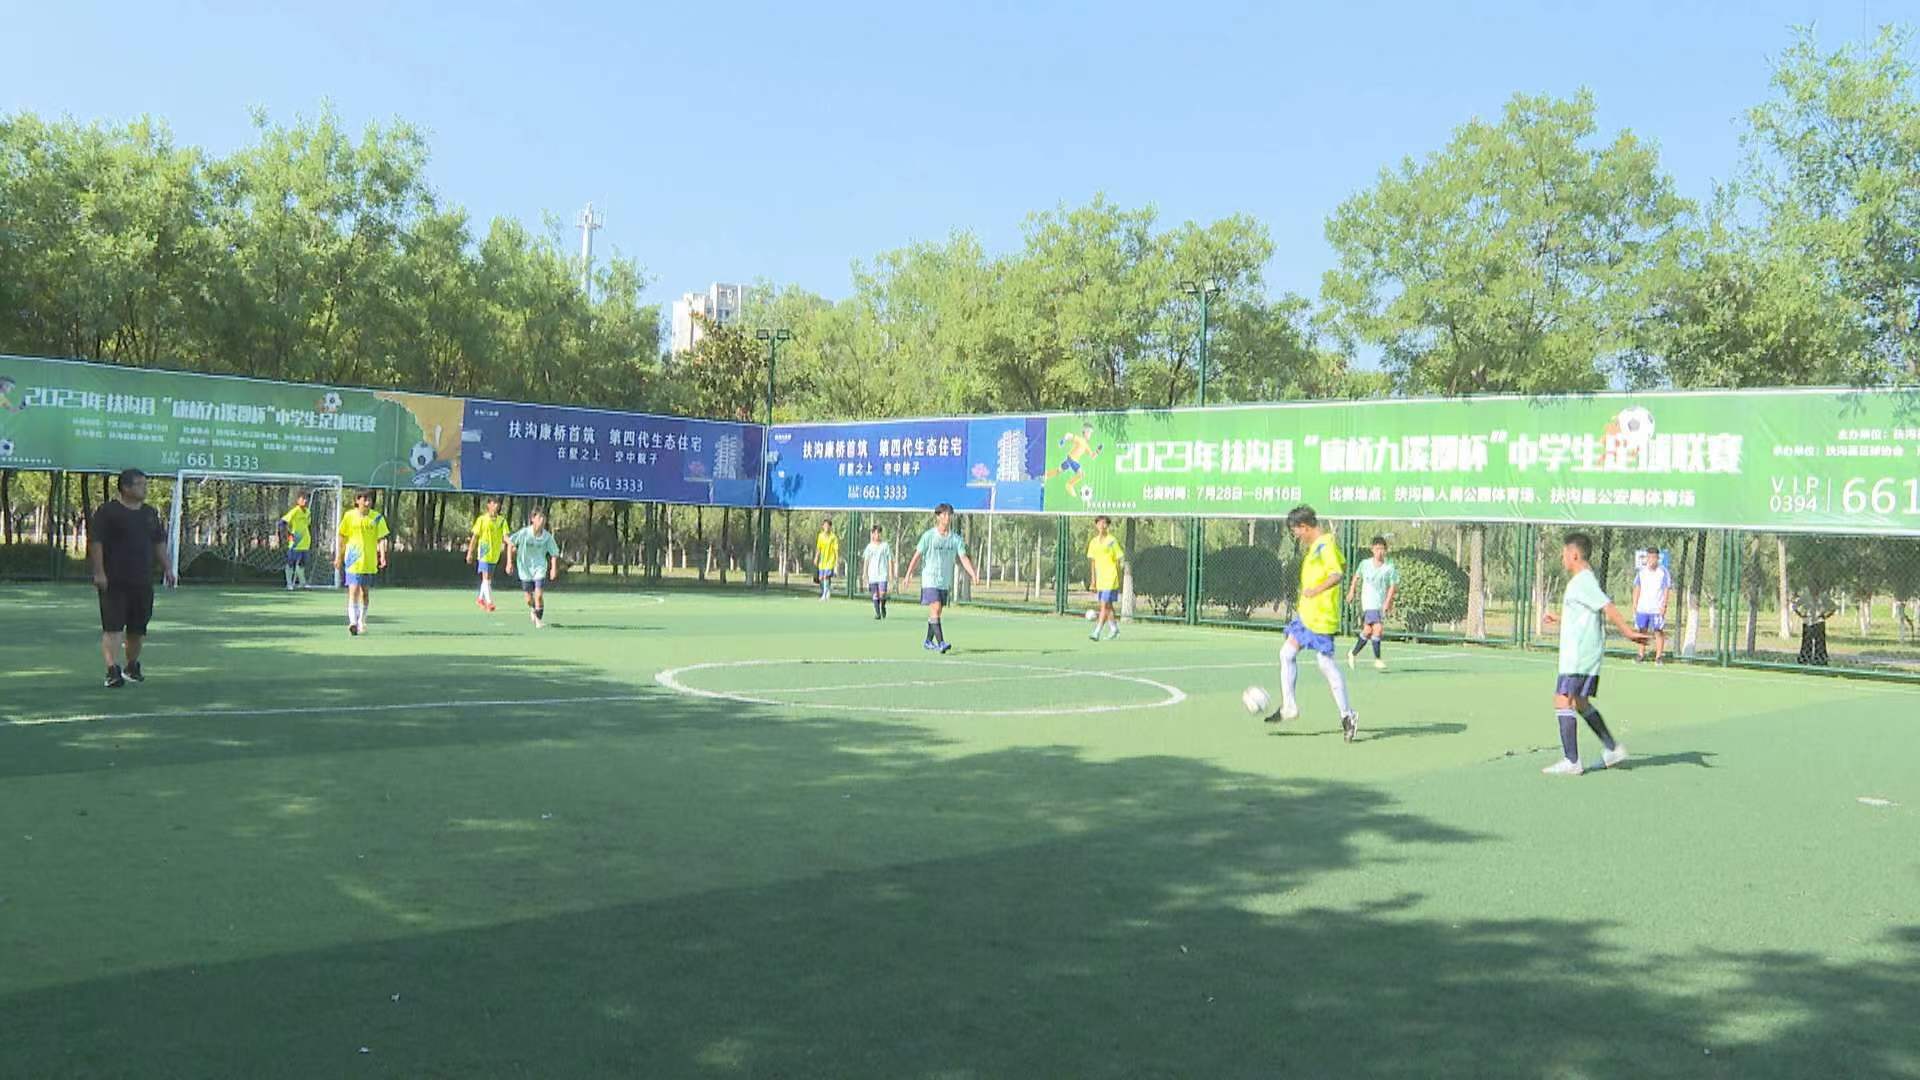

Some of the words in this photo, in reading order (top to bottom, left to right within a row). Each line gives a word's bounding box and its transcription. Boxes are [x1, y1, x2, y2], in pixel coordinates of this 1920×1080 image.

[508, 420, 595, 444] 扶沟康桥首筑
[609, 428, 702, 452] 第四代生态住宅
[803, 439, 868, 459] 扶沟康桥首筑
[879, 436, 962, 459] 第四代生态住宅
[187, 452, 215, 468] 661
[223, 455, 259, 470] 3333
[590, 475, 611, 490] 661
[615, 478, 643, 493] 3333
[863, 485, 881, 500] 661
[884, 485, 908, 500] 3333
[1771, 475, 1819, 496] VIP
[1770, 494, 1817, 513] 0394
[1842, 477, 1920, 515] 661
